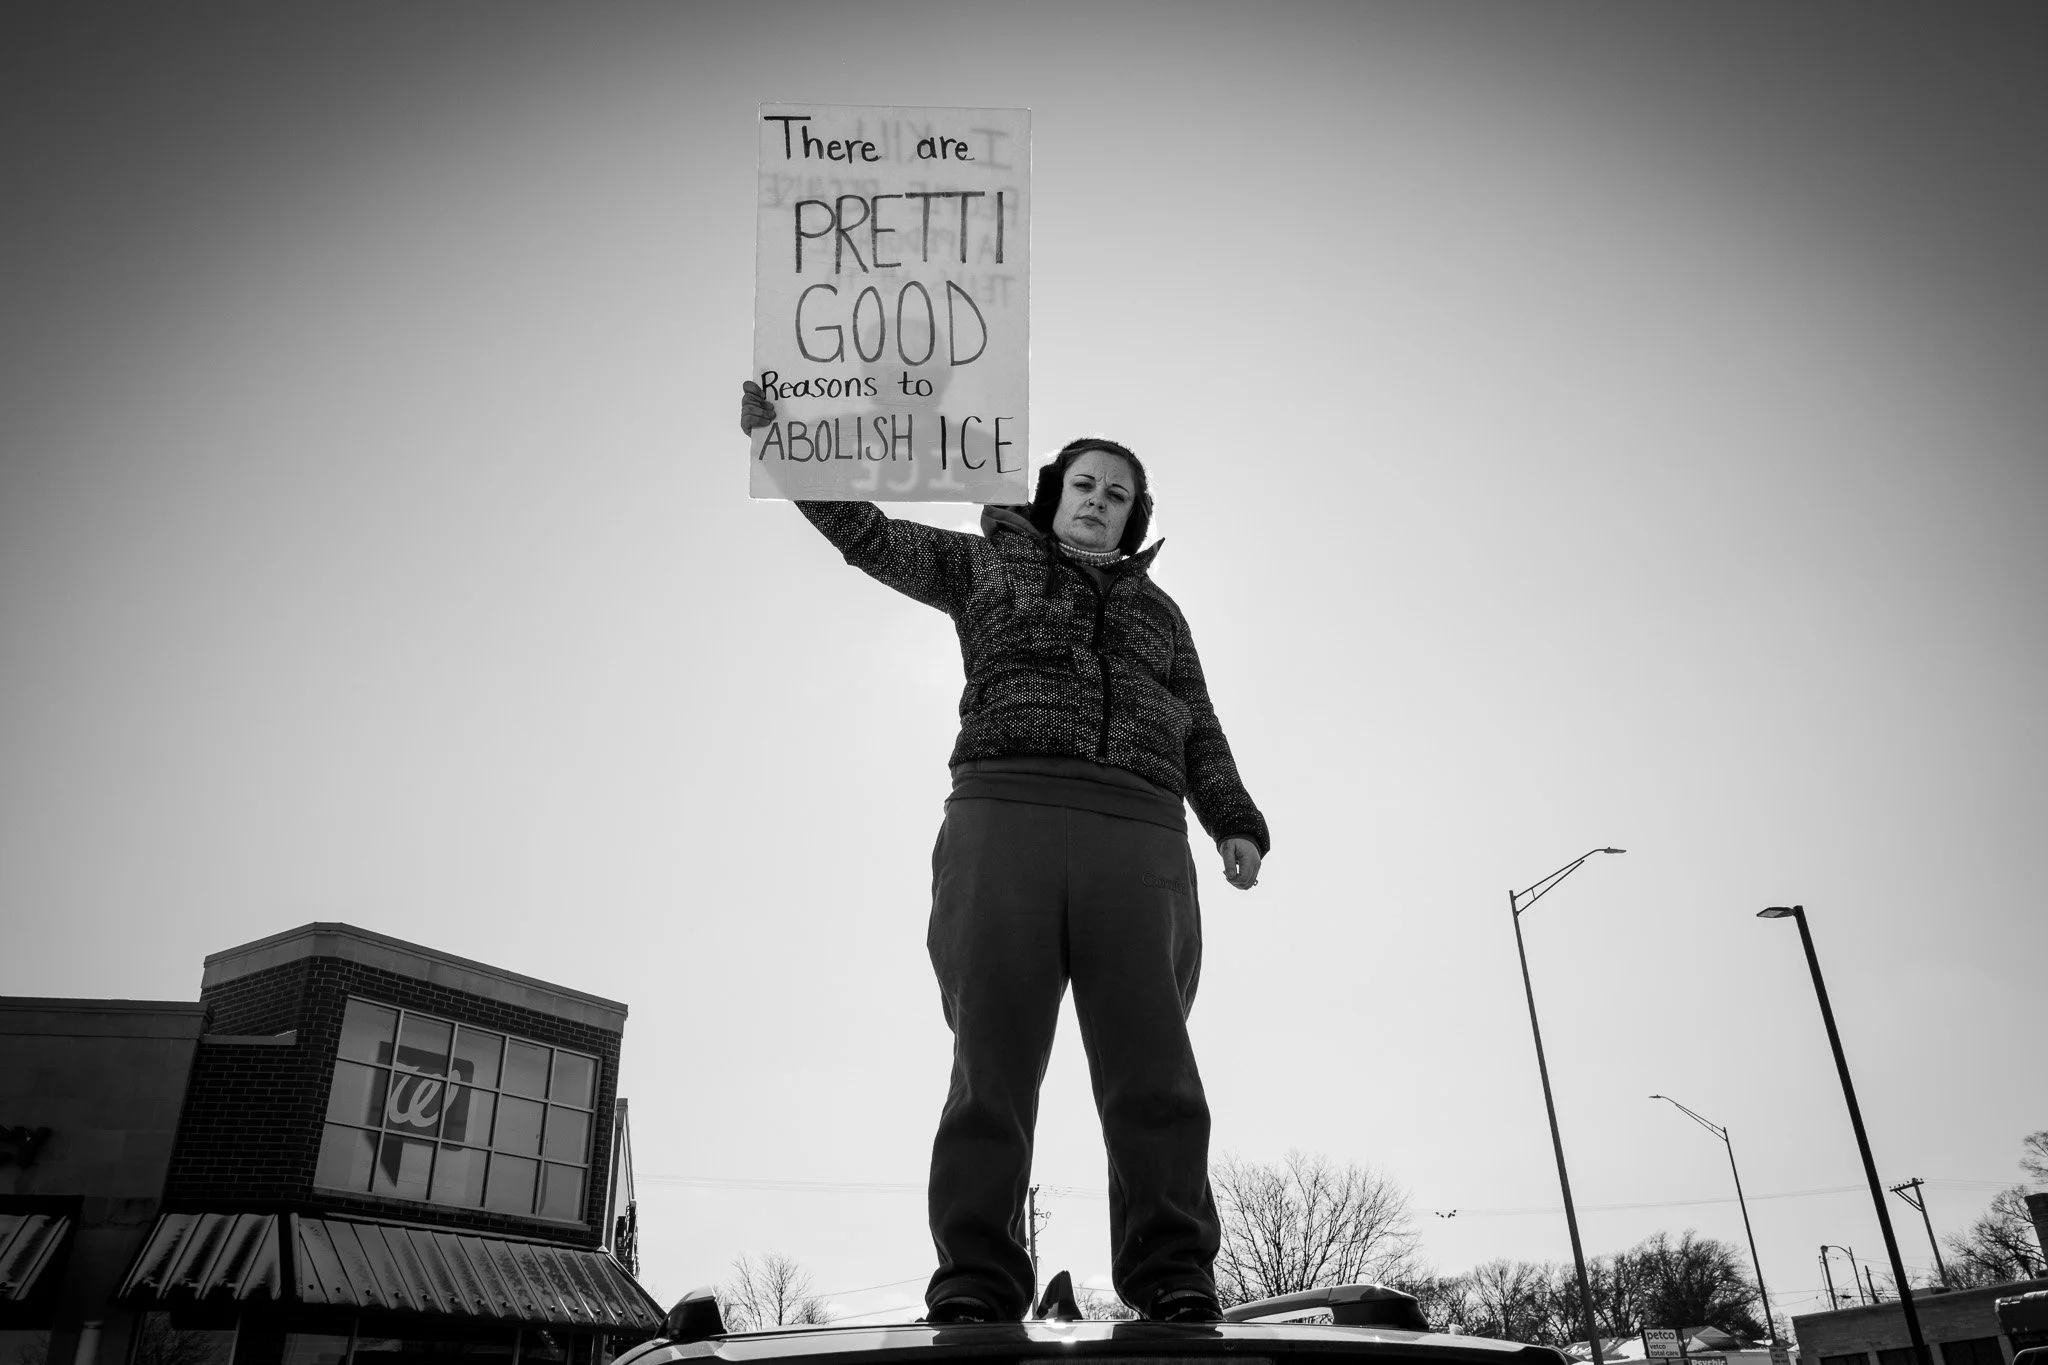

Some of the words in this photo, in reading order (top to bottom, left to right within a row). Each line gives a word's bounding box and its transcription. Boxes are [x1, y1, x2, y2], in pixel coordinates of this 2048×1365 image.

[764, 116, 881, 163] There
[917, 136, 974, 160] are
[795, 191, 1003, 274] PRETTI
[796, 280, 987, 366] GOOD
[761, 371, 877, 401] Reasons
[898, 371, 933, 396] to
[759, 414, 912, 462] ABOLISH
[940, 415, 1021, 473] ICE
[1647, 1331, 1675, 1341] petco
